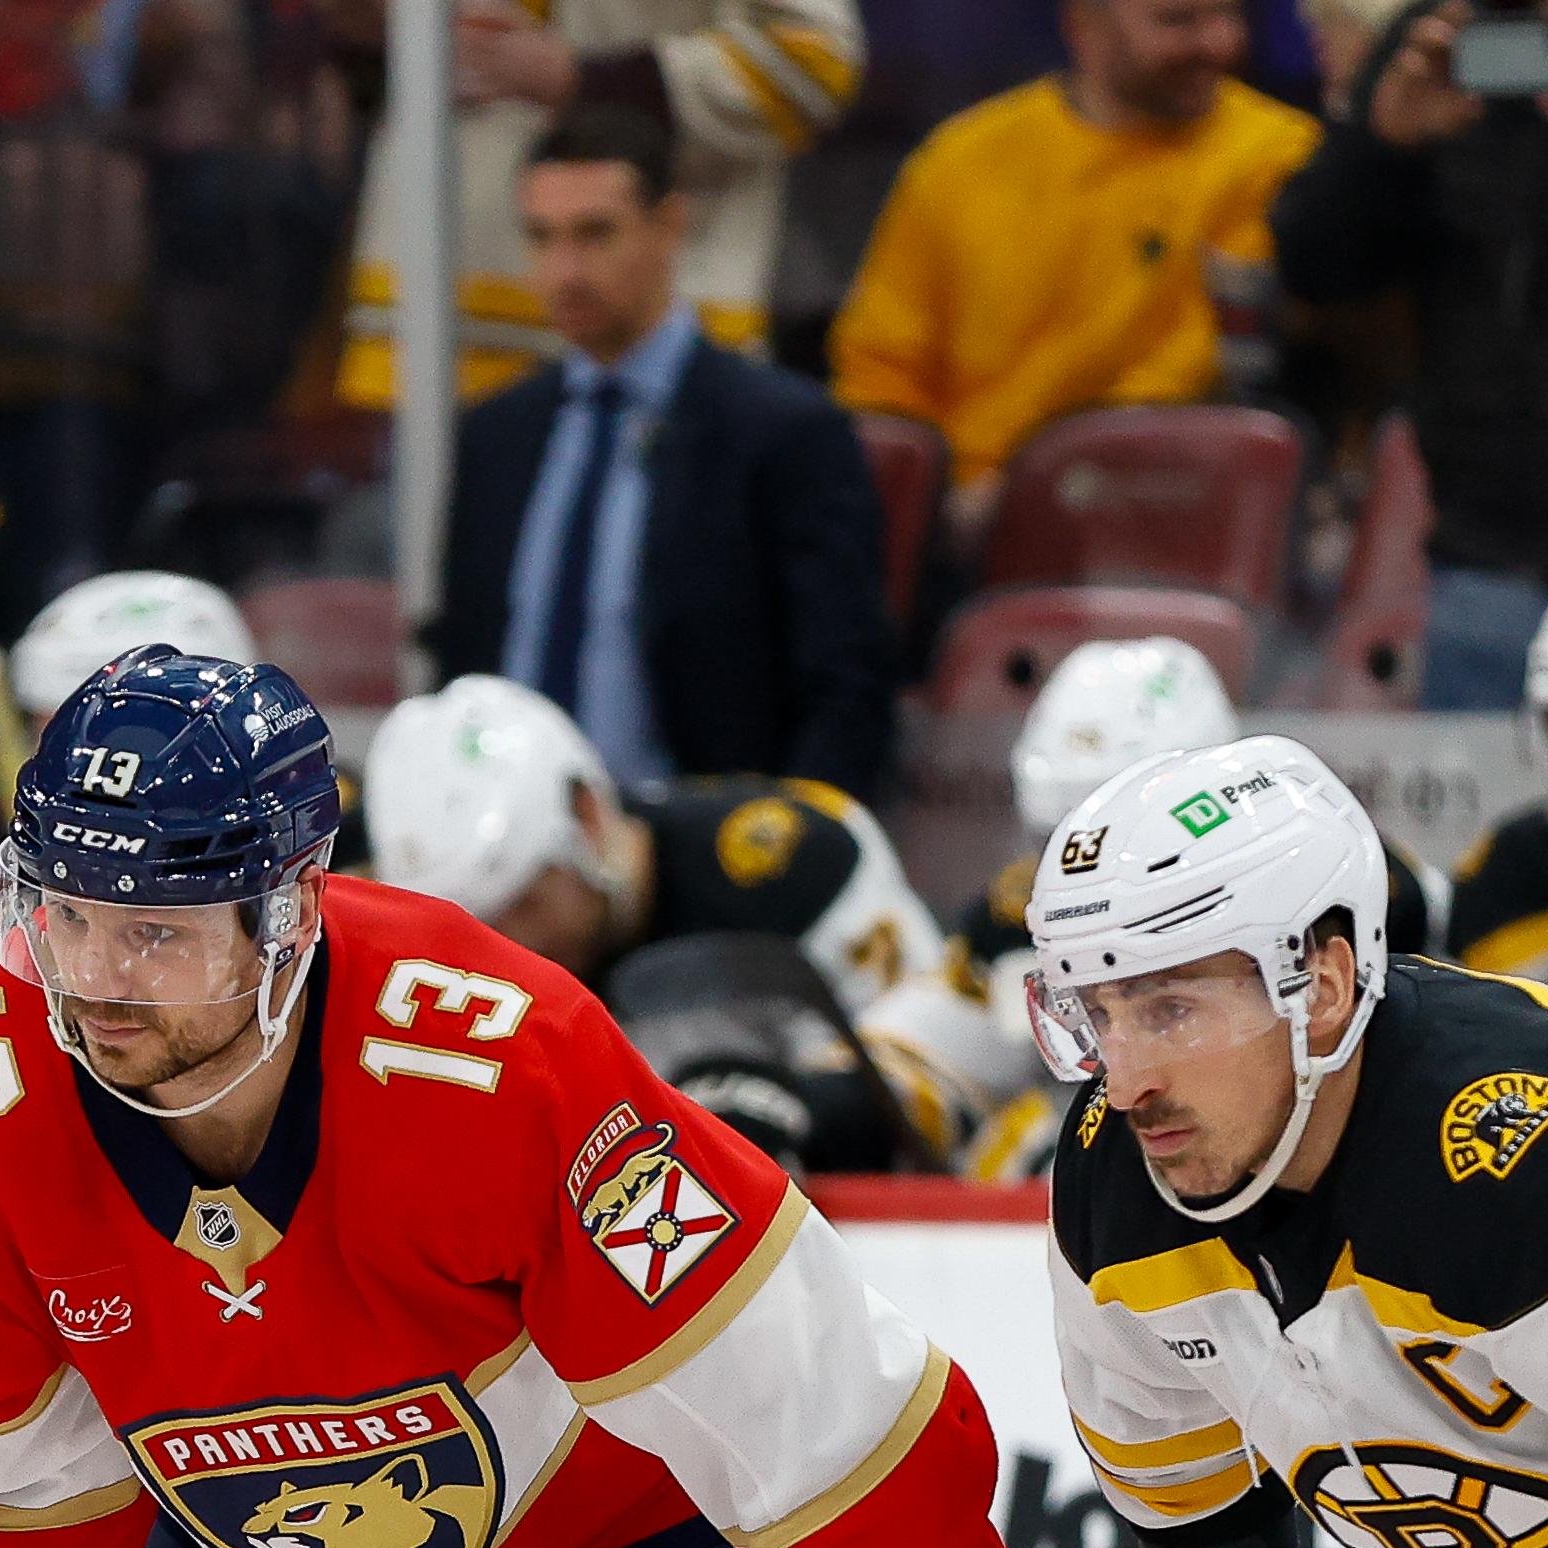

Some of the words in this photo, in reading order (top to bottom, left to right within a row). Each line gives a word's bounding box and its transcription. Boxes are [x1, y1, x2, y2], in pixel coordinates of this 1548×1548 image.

[260, 702, 285, 721] VISIT
[83, 747, 141, 798] 13
[52, 821, 147, 855] CCM
[1060, 825, 1110, 870] 63
[359, 958, 534, 1094] 13
[571, 1113, 630, 1188] FLORIDA
[162, 1404, 433, 1472] PANTHERS
